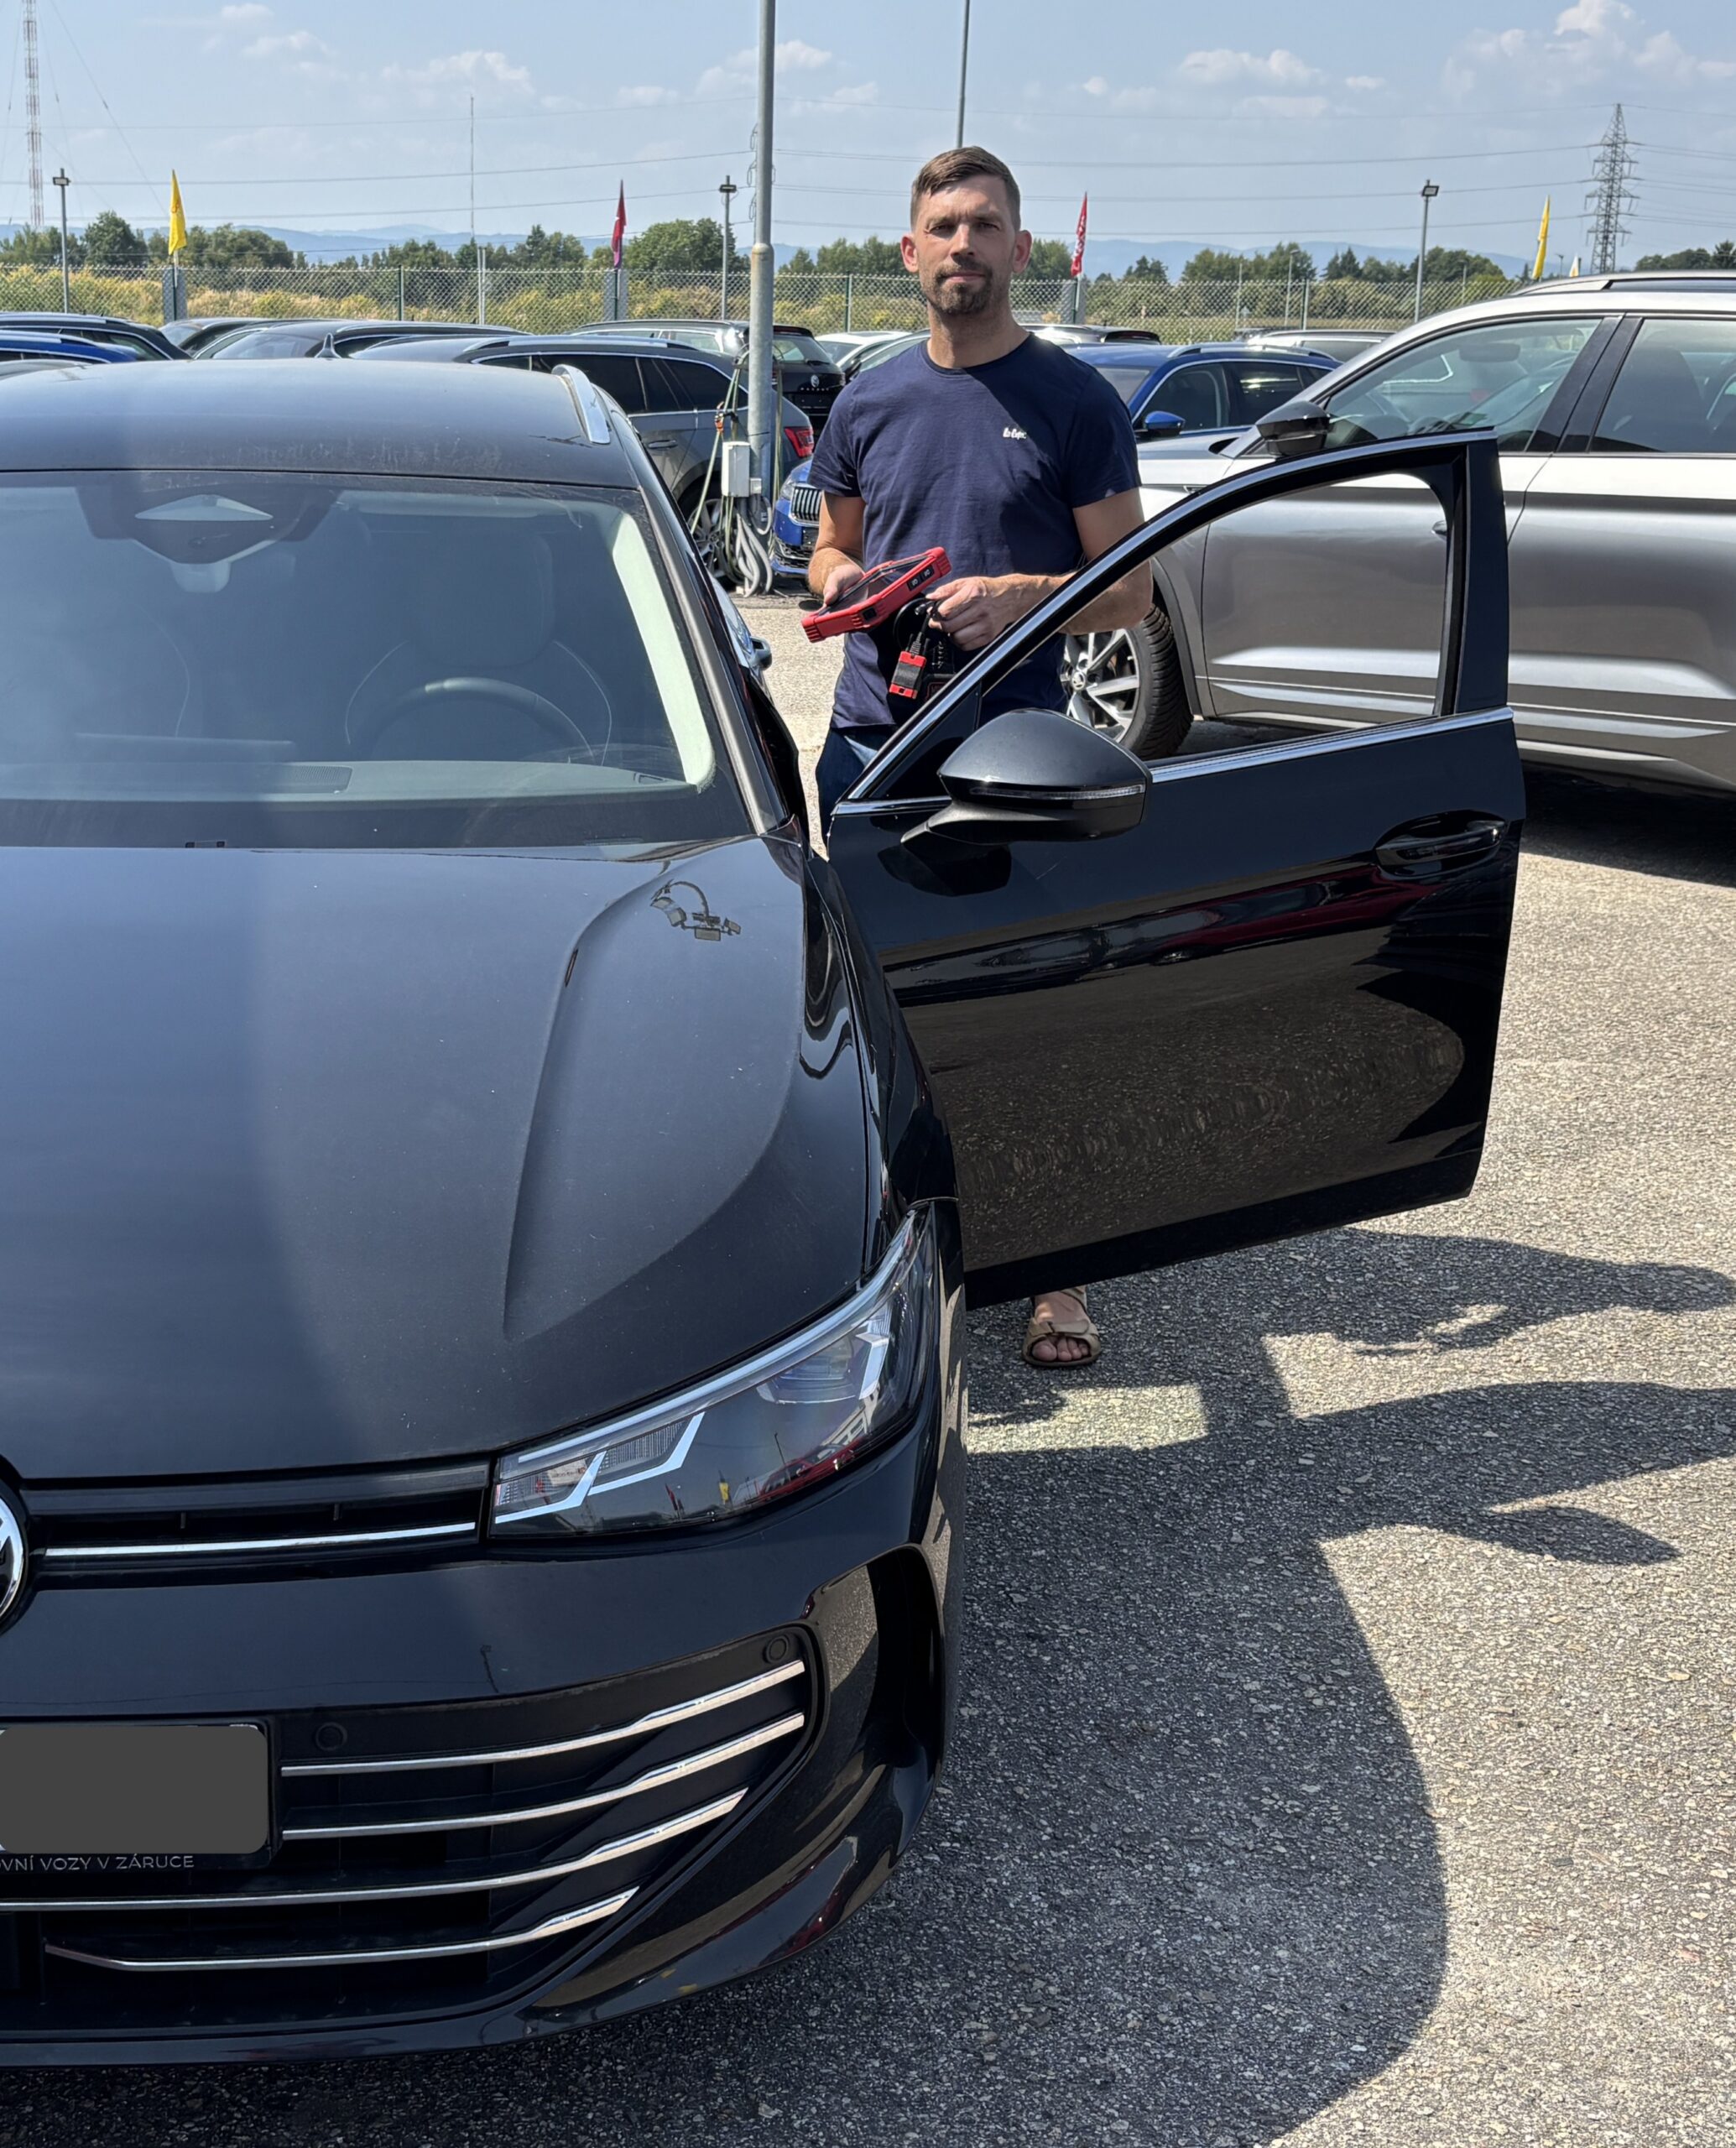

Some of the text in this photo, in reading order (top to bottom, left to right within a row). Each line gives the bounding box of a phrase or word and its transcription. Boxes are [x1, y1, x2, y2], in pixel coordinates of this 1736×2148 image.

[0, 1853, 195, 1871] VNÍ VOZY V ZÁRUCE
